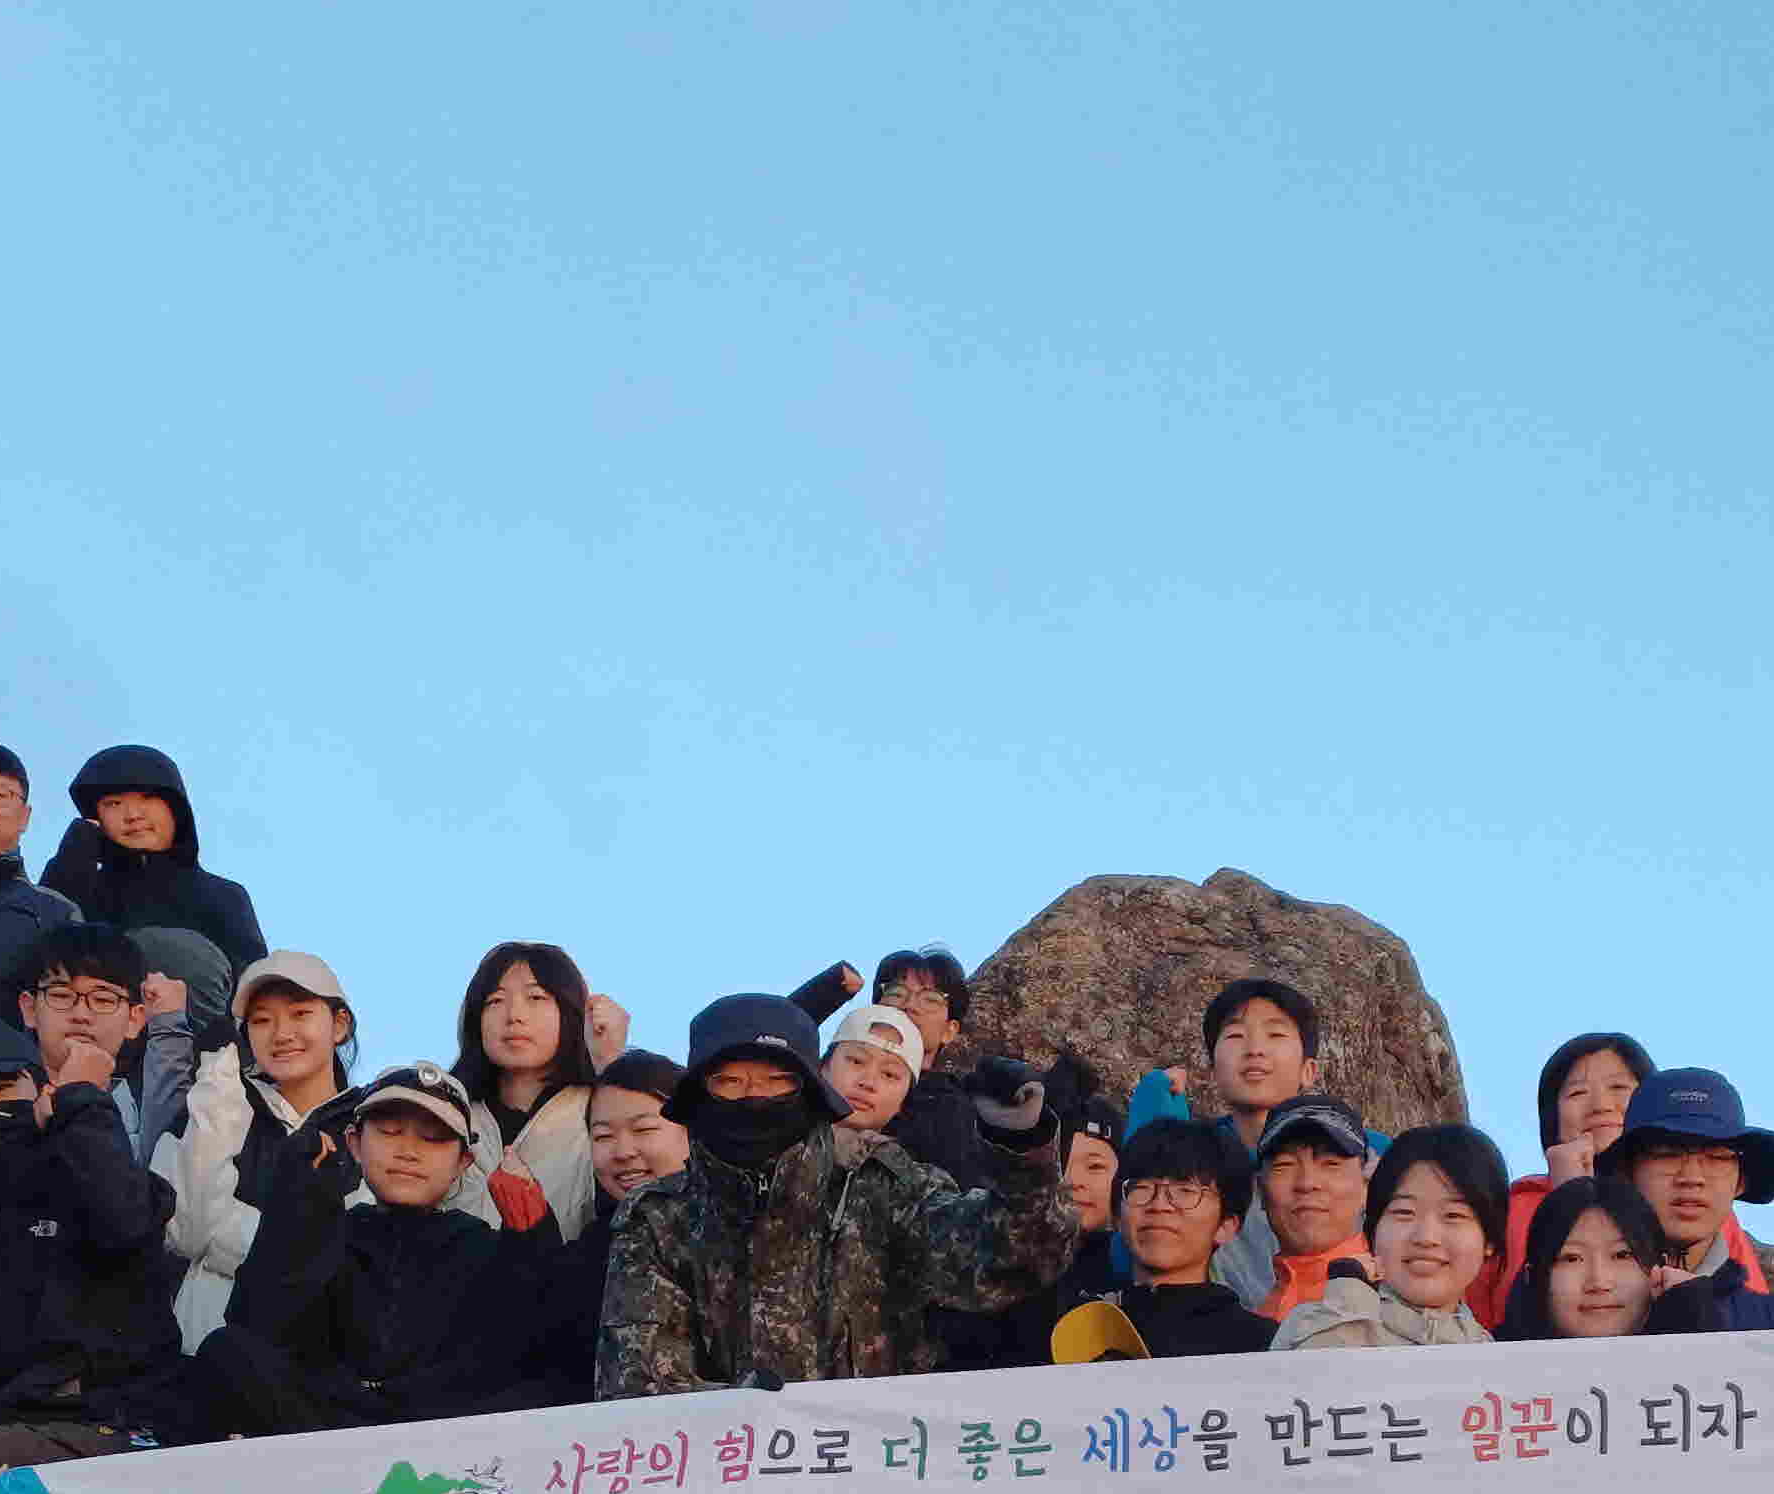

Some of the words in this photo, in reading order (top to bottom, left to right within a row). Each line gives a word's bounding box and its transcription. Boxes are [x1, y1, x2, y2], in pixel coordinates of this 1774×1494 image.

[713, 1424, 852, 1484] 힘으로
[881, 1417, 928, 1481] 더
[957, 1418, 1054, 1482] 좋은
[1082, 1405, 1238, 1473] 세상을
[1264, 1399, 1428, 1466] 만드는
[1461, 1387, 1609, 1462] 일꾼이
[1639, 1382, 1757, 1453] 되자
